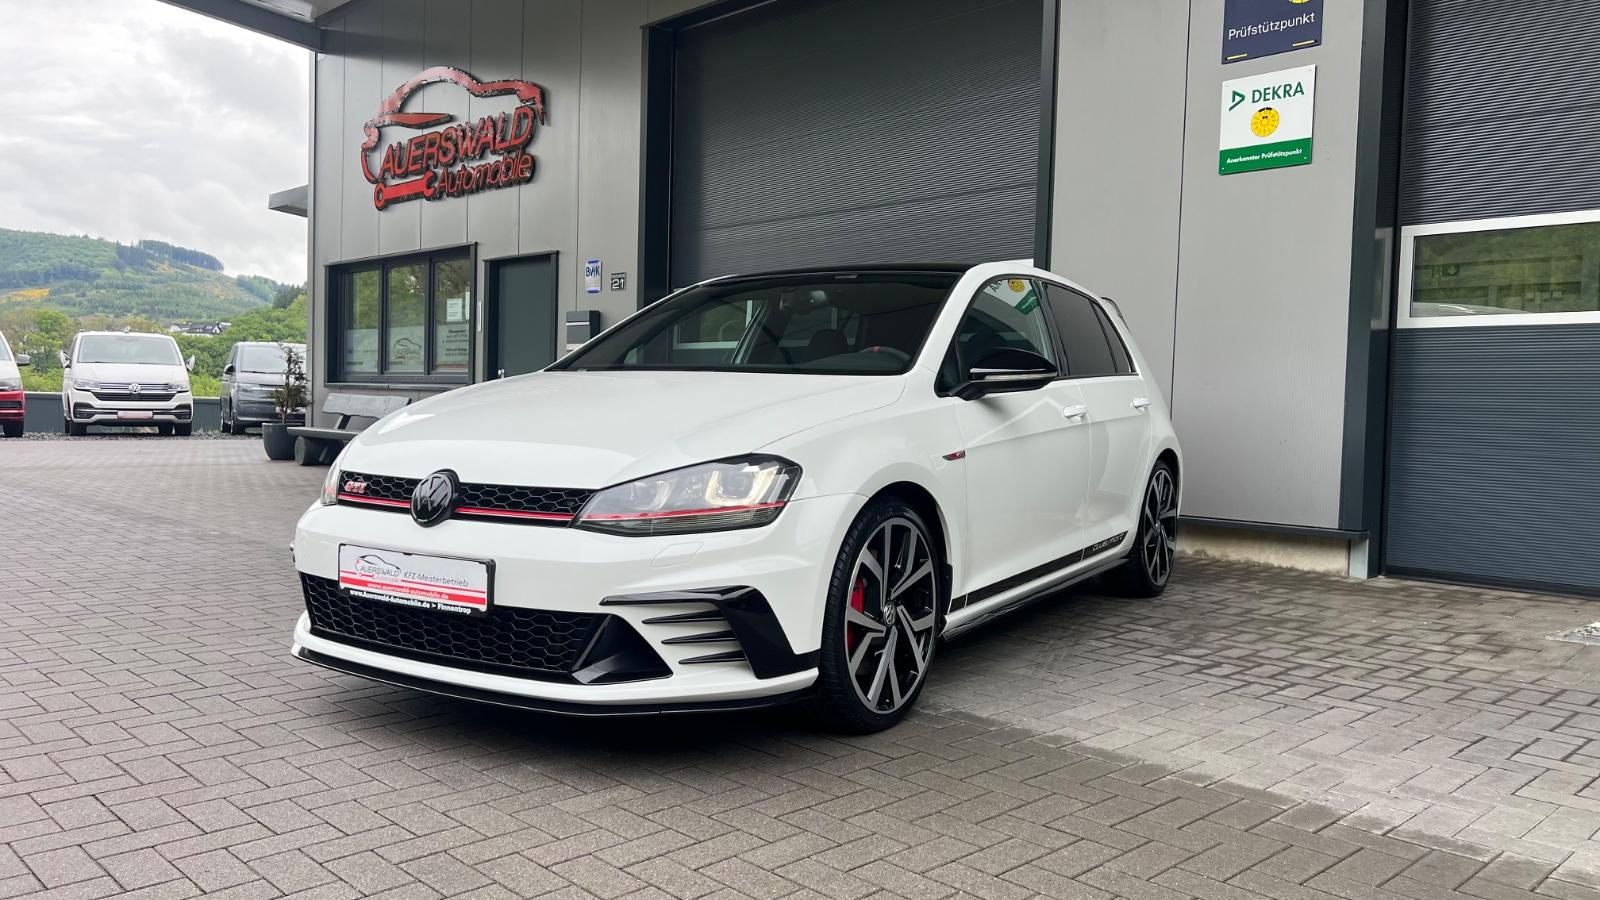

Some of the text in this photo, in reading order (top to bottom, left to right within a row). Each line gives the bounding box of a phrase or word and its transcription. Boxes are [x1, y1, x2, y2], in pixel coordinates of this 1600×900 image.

[1228, 12, 1315, 40] Prüfstützpunkt
[1252, 81, 1304, 104] DEKRA
[379, 106, 536, 180] AUERSWALD
[435, 151, 534, 197] Automobile
[612, 278, 625, 289] 21
[361, 565, 399, 577] AUERSWALD
[404, 571, 469, 587] KFZ-Meisterbetrieb
[437, 603, 471, 614] Finnentrop
